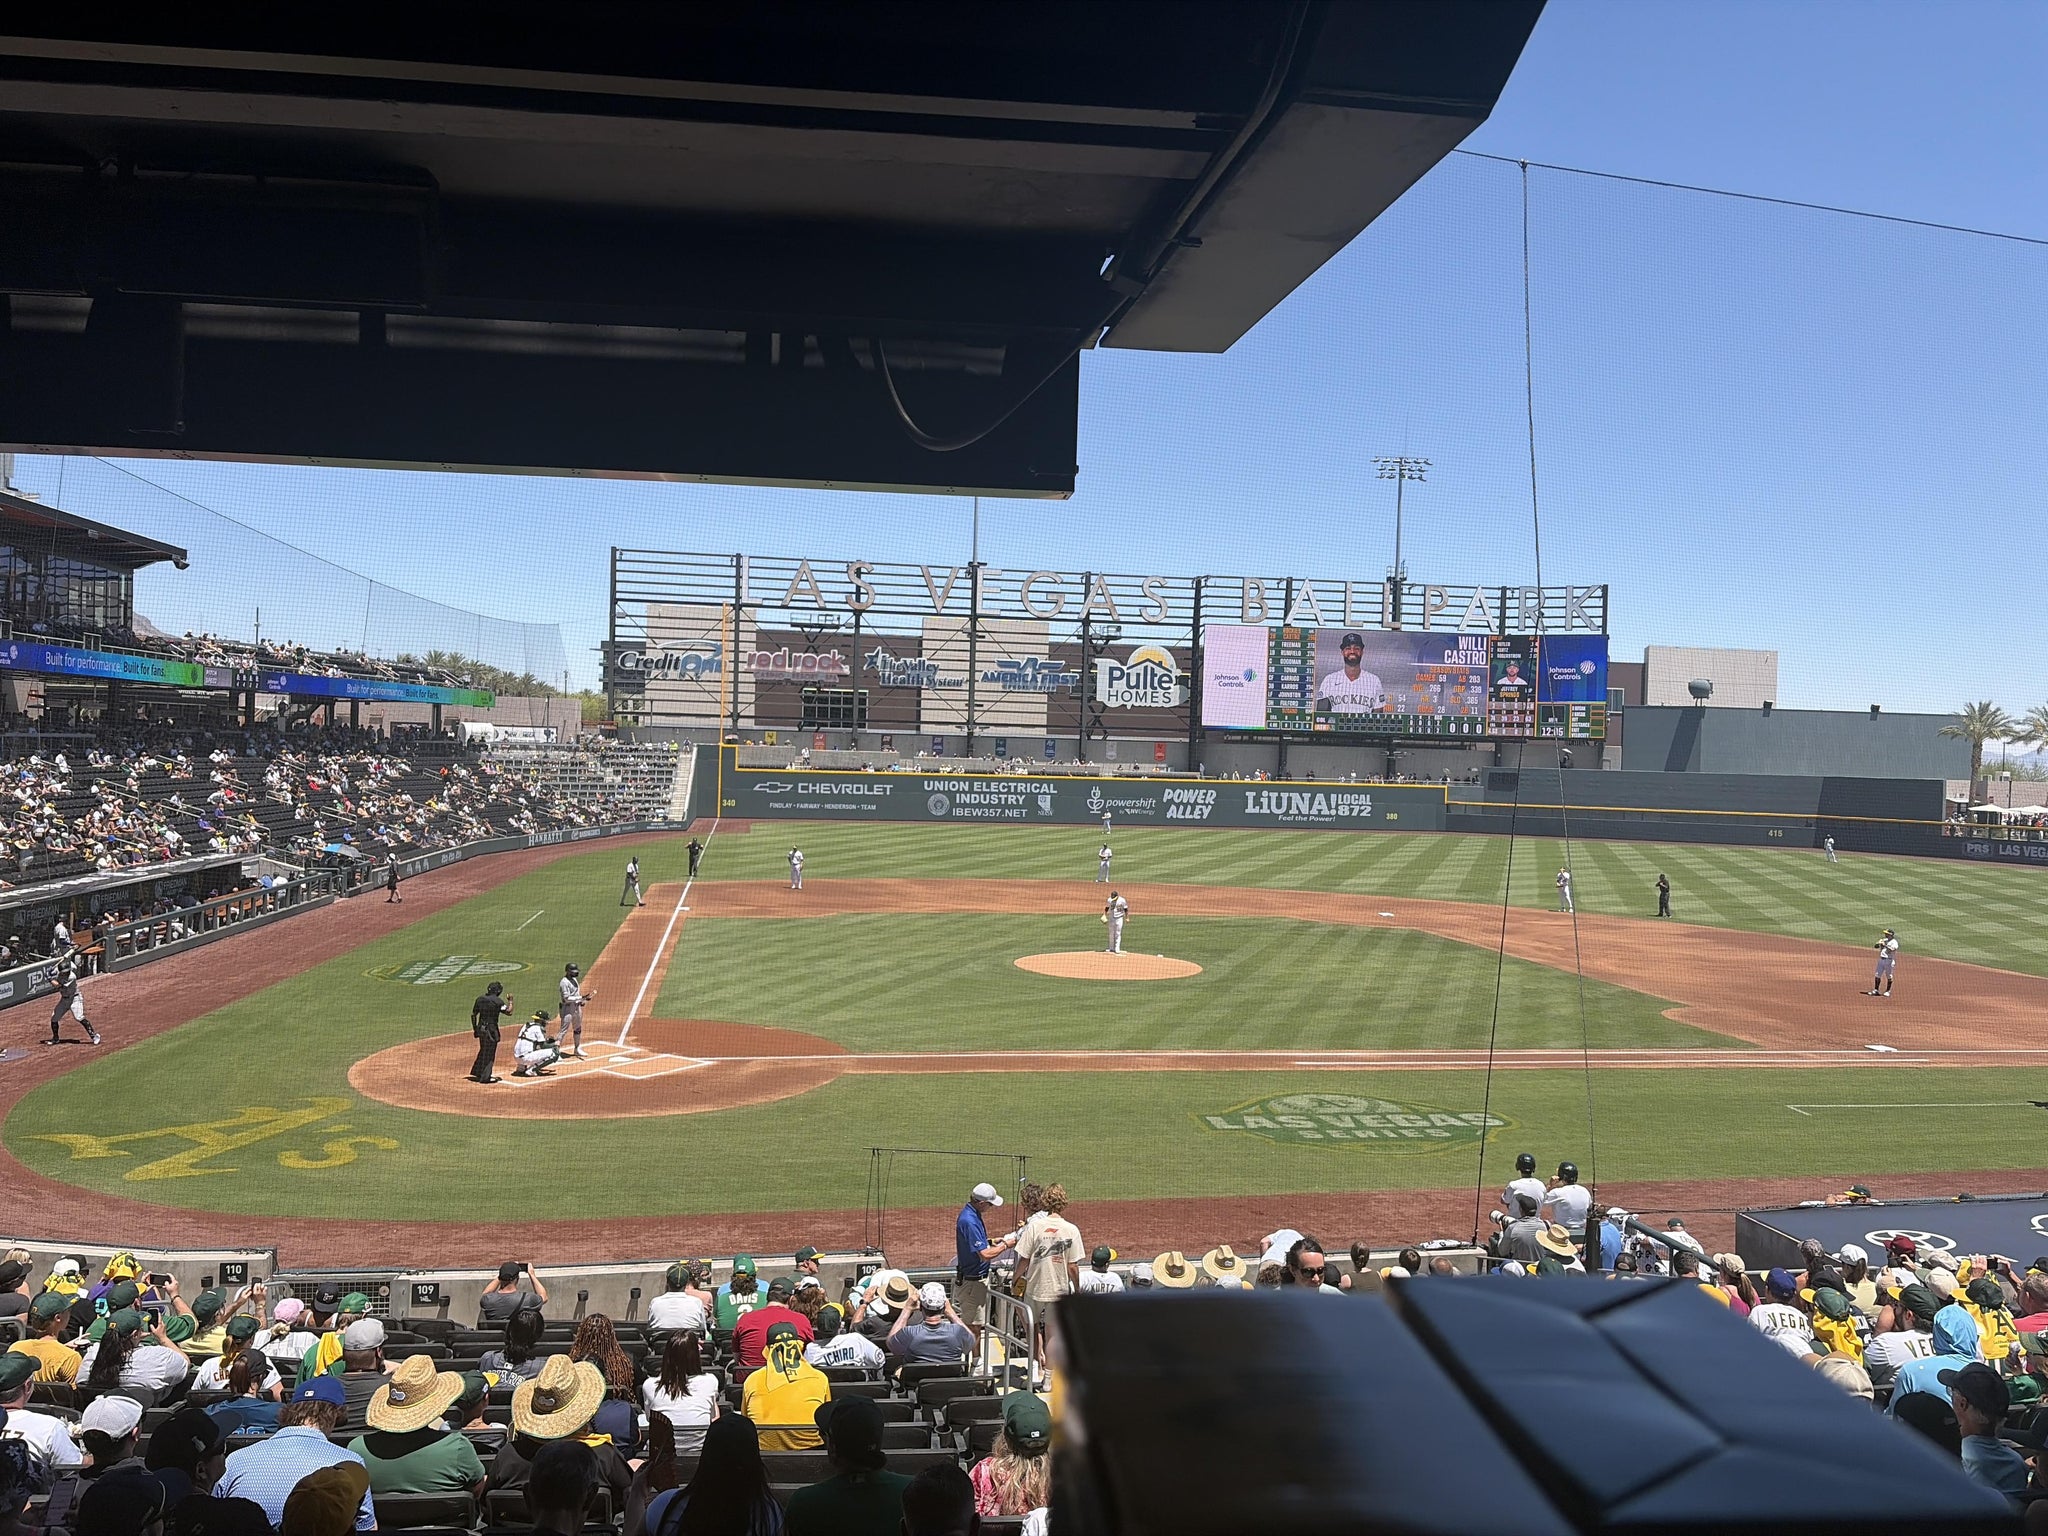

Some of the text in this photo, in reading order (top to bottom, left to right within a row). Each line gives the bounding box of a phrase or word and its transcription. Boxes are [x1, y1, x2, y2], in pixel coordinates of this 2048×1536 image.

[741, 556, 1602, 632] LAS VEGAS BALLPARK
[1458, 636, 1487, 651] WILLI
[45, 651, 63, 666] Built
[65, 653, 77, 667] for
[123, 660, 140, 675] Built
[141, 661, 151, 676] for
[151, 663, 166, 677] fans.
[618, 650, 681, 671] Credit
[746, 647, 847, 674] red rock
[880, 654, 940, 675] The Valley
[1444, 650, 1486, 665] CASTRO
[880, 670, 966, 689] Health System
[981, 670, 1079, 687] AMERICA FIRST
[1107, 663, 1174, 691] Pulte
[1213, 673, 1240, 681] Johnson
[1218, 680, 1244, 688] Controls
[346, 684, 361, 694] Built
[361, 685, 370, 695] for
[405, 688, 418, 698] Built
[418, 688, 426, 698] for
[426, 689, 440, 700] fans.
[1107, 690, 1172, 704] HOMES
[1328, 694, 1375, 708] ROCKIES
[1397, 704, 1405, 712] 22
[1450, 723, 1482, 734] 0 0 0
[797, 782, 894, 796] CHEVROLET
[923, 780, 1058, 794] UNION ELECTRICAL
[722, 799, 736, 807] 340
[955, 793, 1026, 806] INDUSTRY
[1105, 797, 1156, 810] powershift
[1162, 788, 1217, 805] POWER
[1244, 790, 1337, 816] LiUNA!
[1337, 793, 1372, 805] LOCAL
[952, 807, 1028, 818] IBEW357.NET
[1166, 803, 1213, 820] ALLEY
[1337, 804, 1372, 817] 872
[528, 831, 563, 846] HANRATTY
[1768, 829, 1783, 838] 415
[1966, 843, 1990, 853] PRS
[1999, 844, 2021, 856] LAS
[100, 889, 129, 903] FRIEDMAN
[26, 904, 60, 920] FRIEDMAN
[27, 970, 43, 989] TED
[1205, 1111, 1504, 1131] LAS VEGAS
[1299, 1128, 1452, 1139] SERIES
[225, 1265, 242, 1275] 110
[860, 1265, 878, 1275] 109
[416, 1285, 434, 1295] 109
[1090, 1283, 1116, 1293] KURTZ
[728, 1292, 758, 1306] DAVIS
[823, 1346, 856, 1366] ICHIRO
